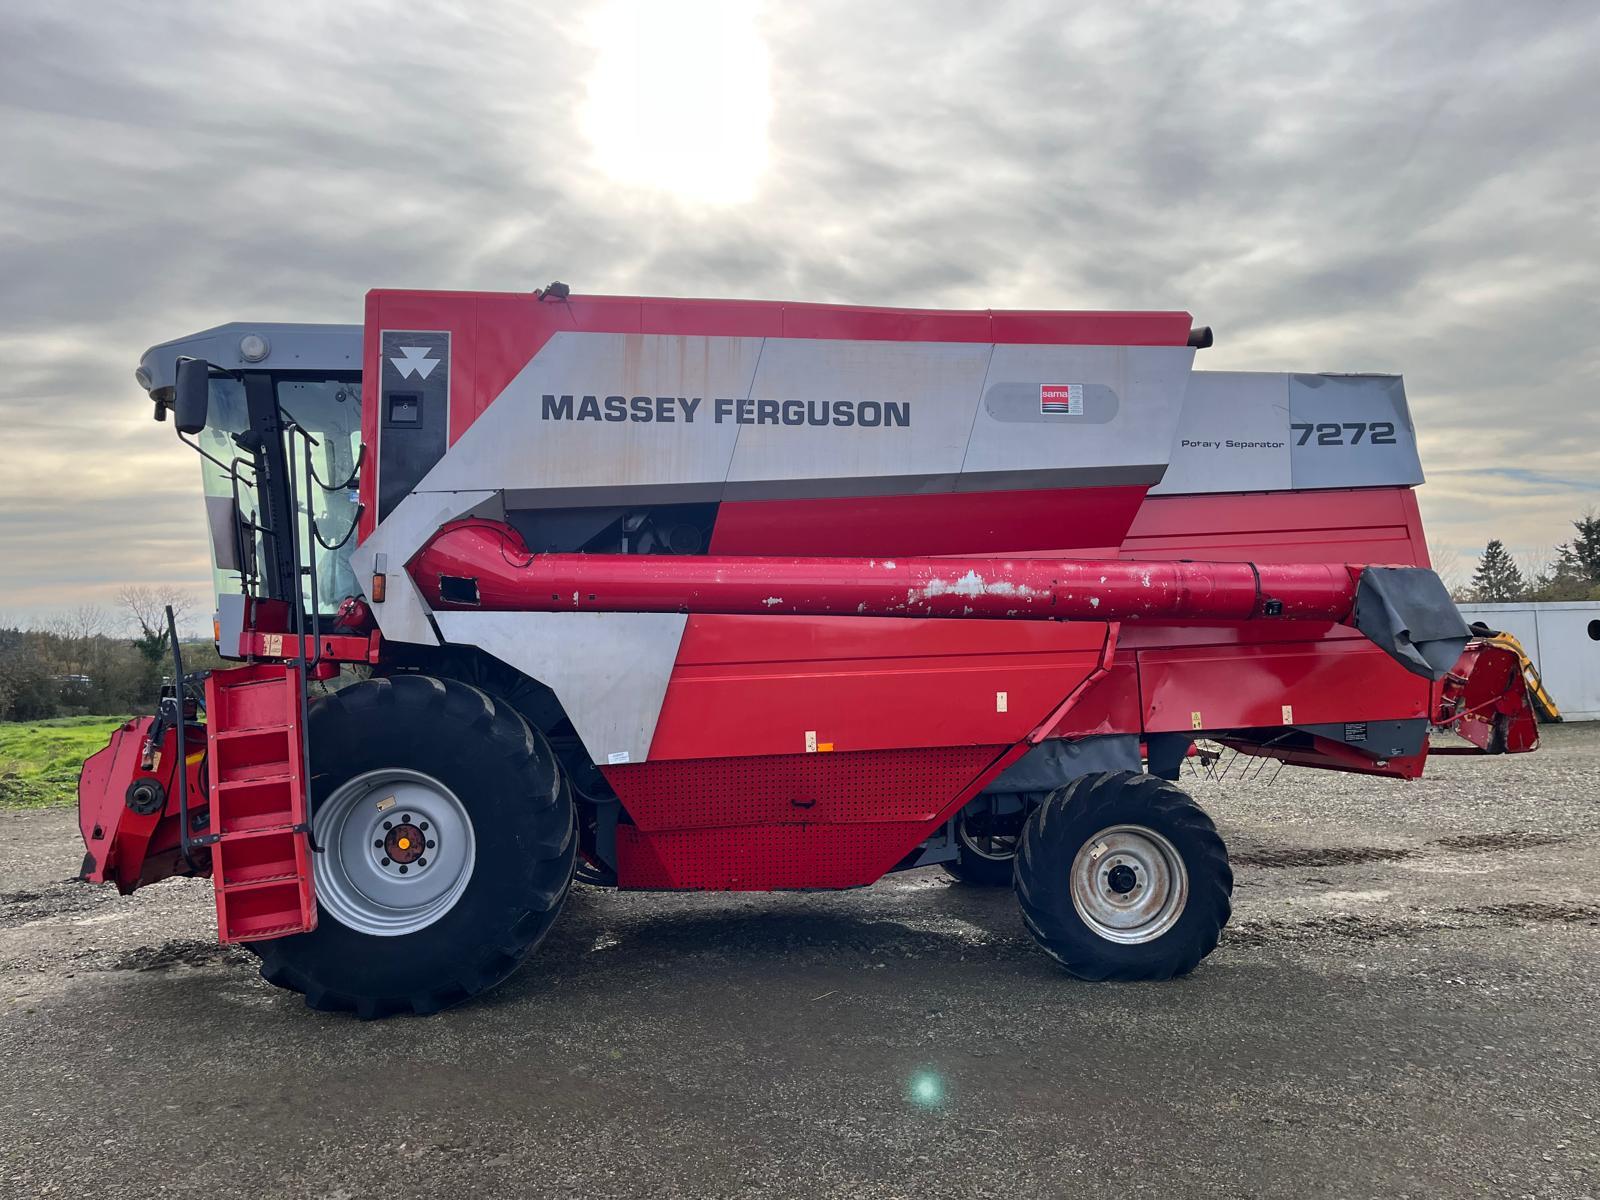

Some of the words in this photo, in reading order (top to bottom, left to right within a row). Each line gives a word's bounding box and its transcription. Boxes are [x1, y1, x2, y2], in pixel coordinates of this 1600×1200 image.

[541, 394, 702, 423] MASSEY
[714, 398, 910, 427] FERGUSON
[1225, 440, 1285, 449] Separator
[1291, 422, 1397, 446] 7272
